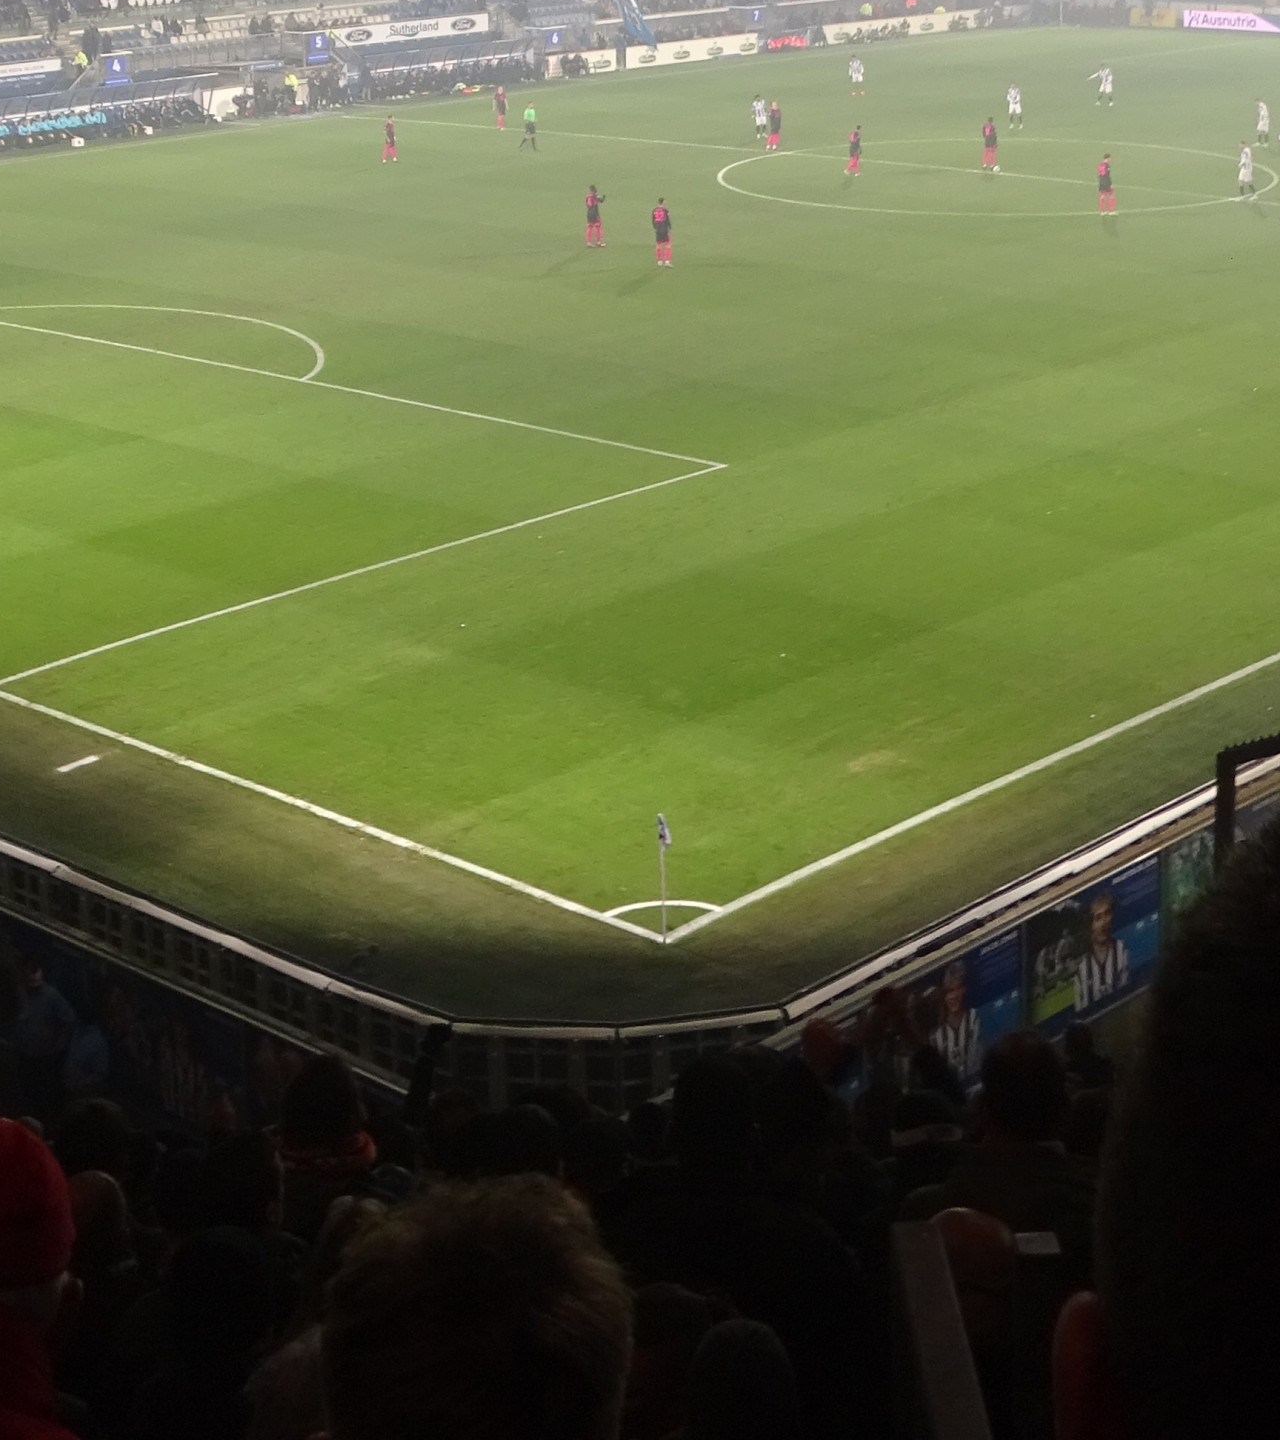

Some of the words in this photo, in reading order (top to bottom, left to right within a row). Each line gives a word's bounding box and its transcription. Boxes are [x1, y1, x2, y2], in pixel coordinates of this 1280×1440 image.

[390, 21, 439, 35] Sutherland
[1202, 14, 1257, 28] Ausnutria
[315, 36, 322, 48] 5
[552, 32, 558, 44] 6
[112, 59, 121, 73] 4
